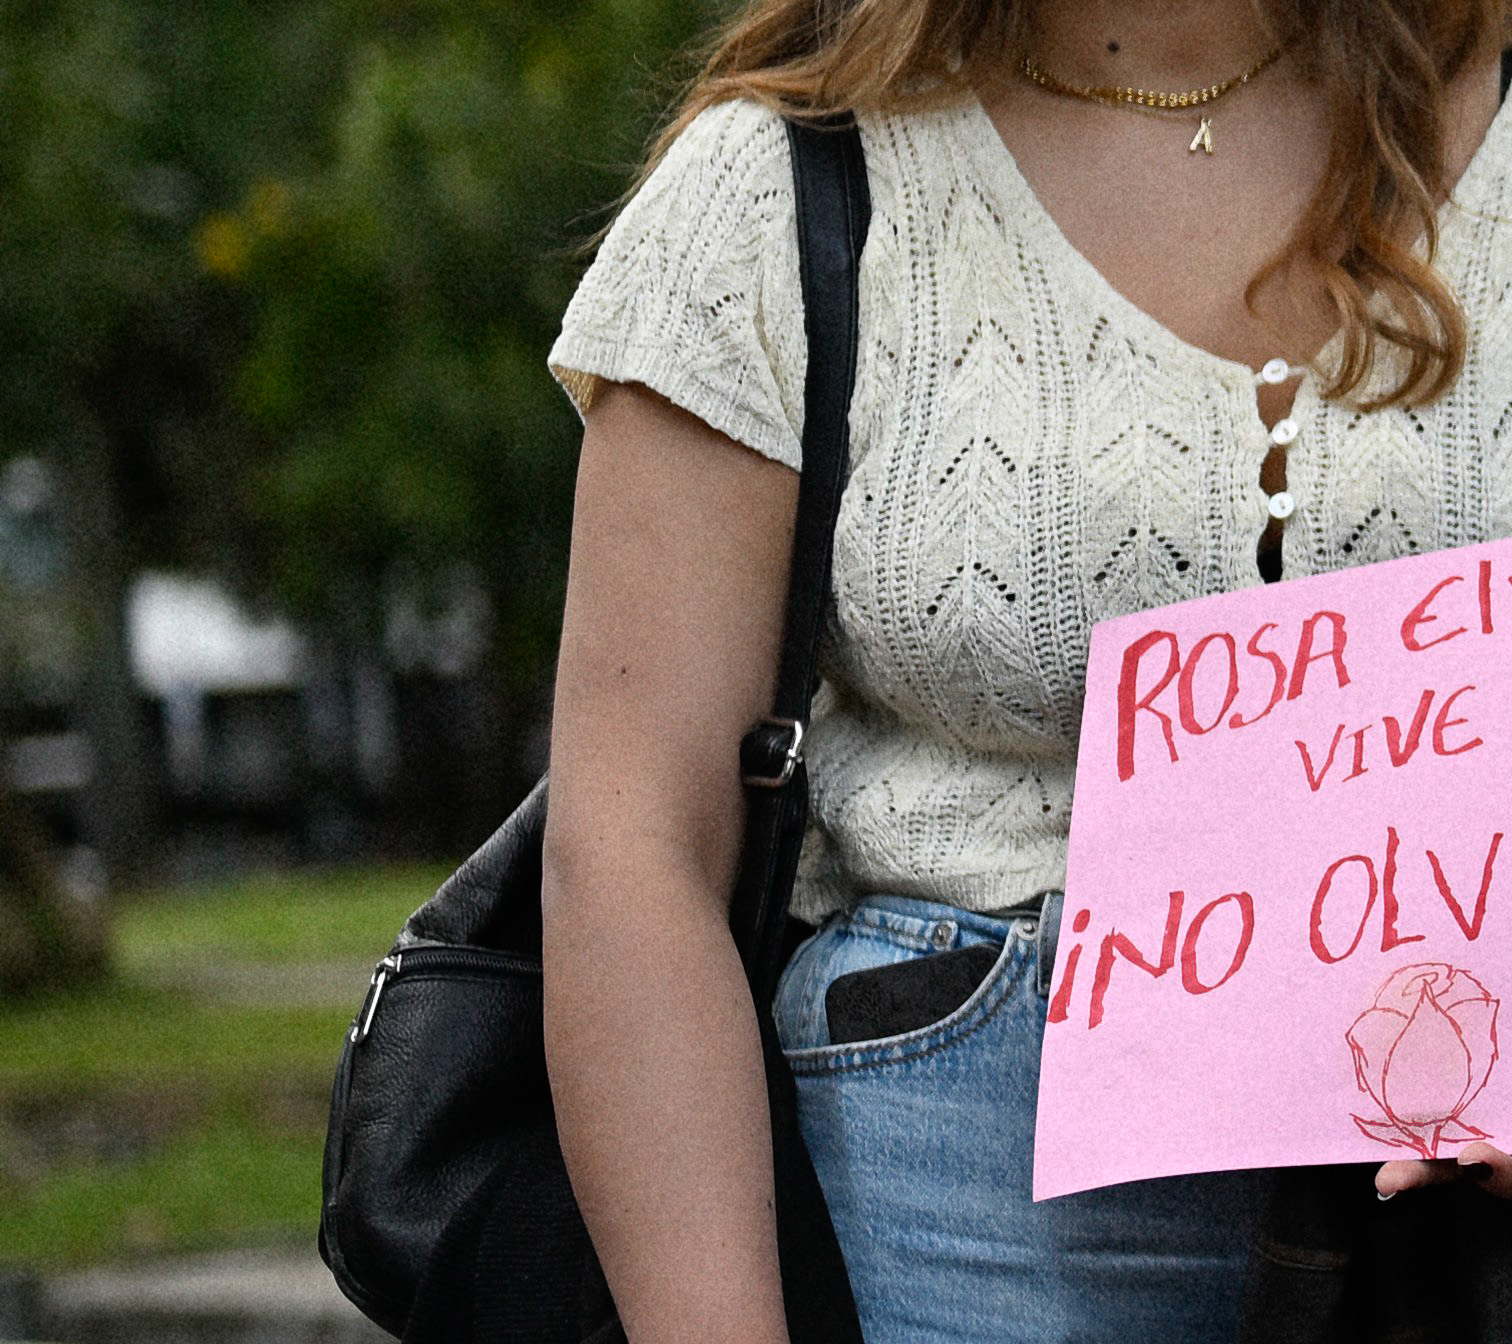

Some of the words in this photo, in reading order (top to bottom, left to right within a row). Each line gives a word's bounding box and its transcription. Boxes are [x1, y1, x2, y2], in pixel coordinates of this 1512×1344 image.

[1117, 611, 1350, 781] ROSA
[1294, 684, 1484, 792] VIVE
[1047, 891, 1255, 1029] ¡NO
